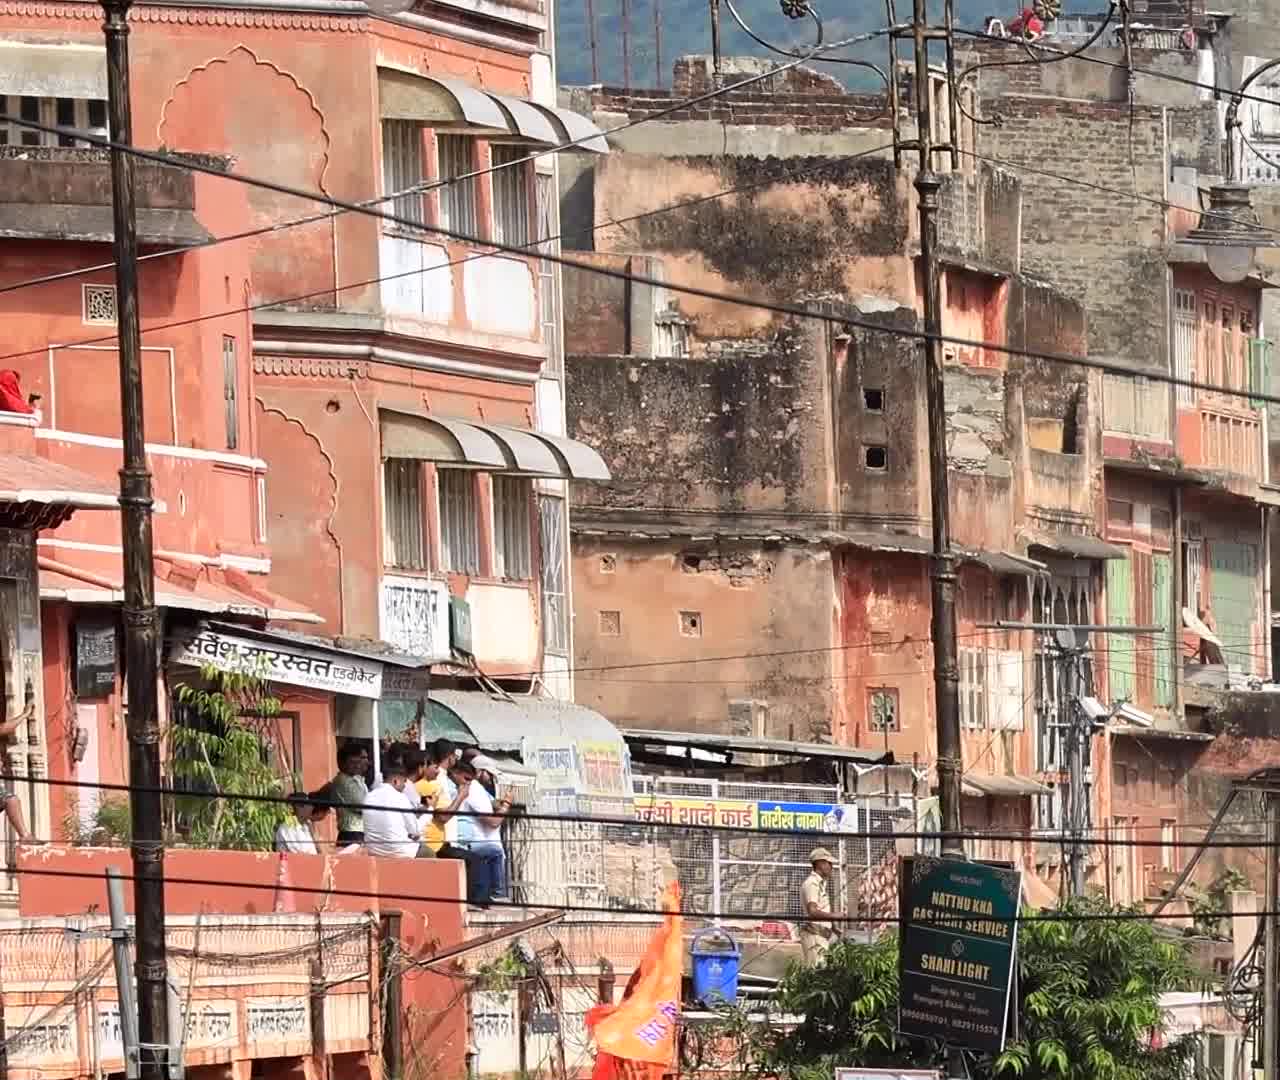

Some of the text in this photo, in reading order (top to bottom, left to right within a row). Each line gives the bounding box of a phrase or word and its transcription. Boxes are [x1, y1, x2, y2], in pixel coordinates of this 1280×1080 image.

[679, 803, 715, 827] शादी
[721, 803, 753, 828] कार्ड
[965, 920, 1009, 938] SERVICE
[920, 953, 991, 981] SHAHI LIGHT
